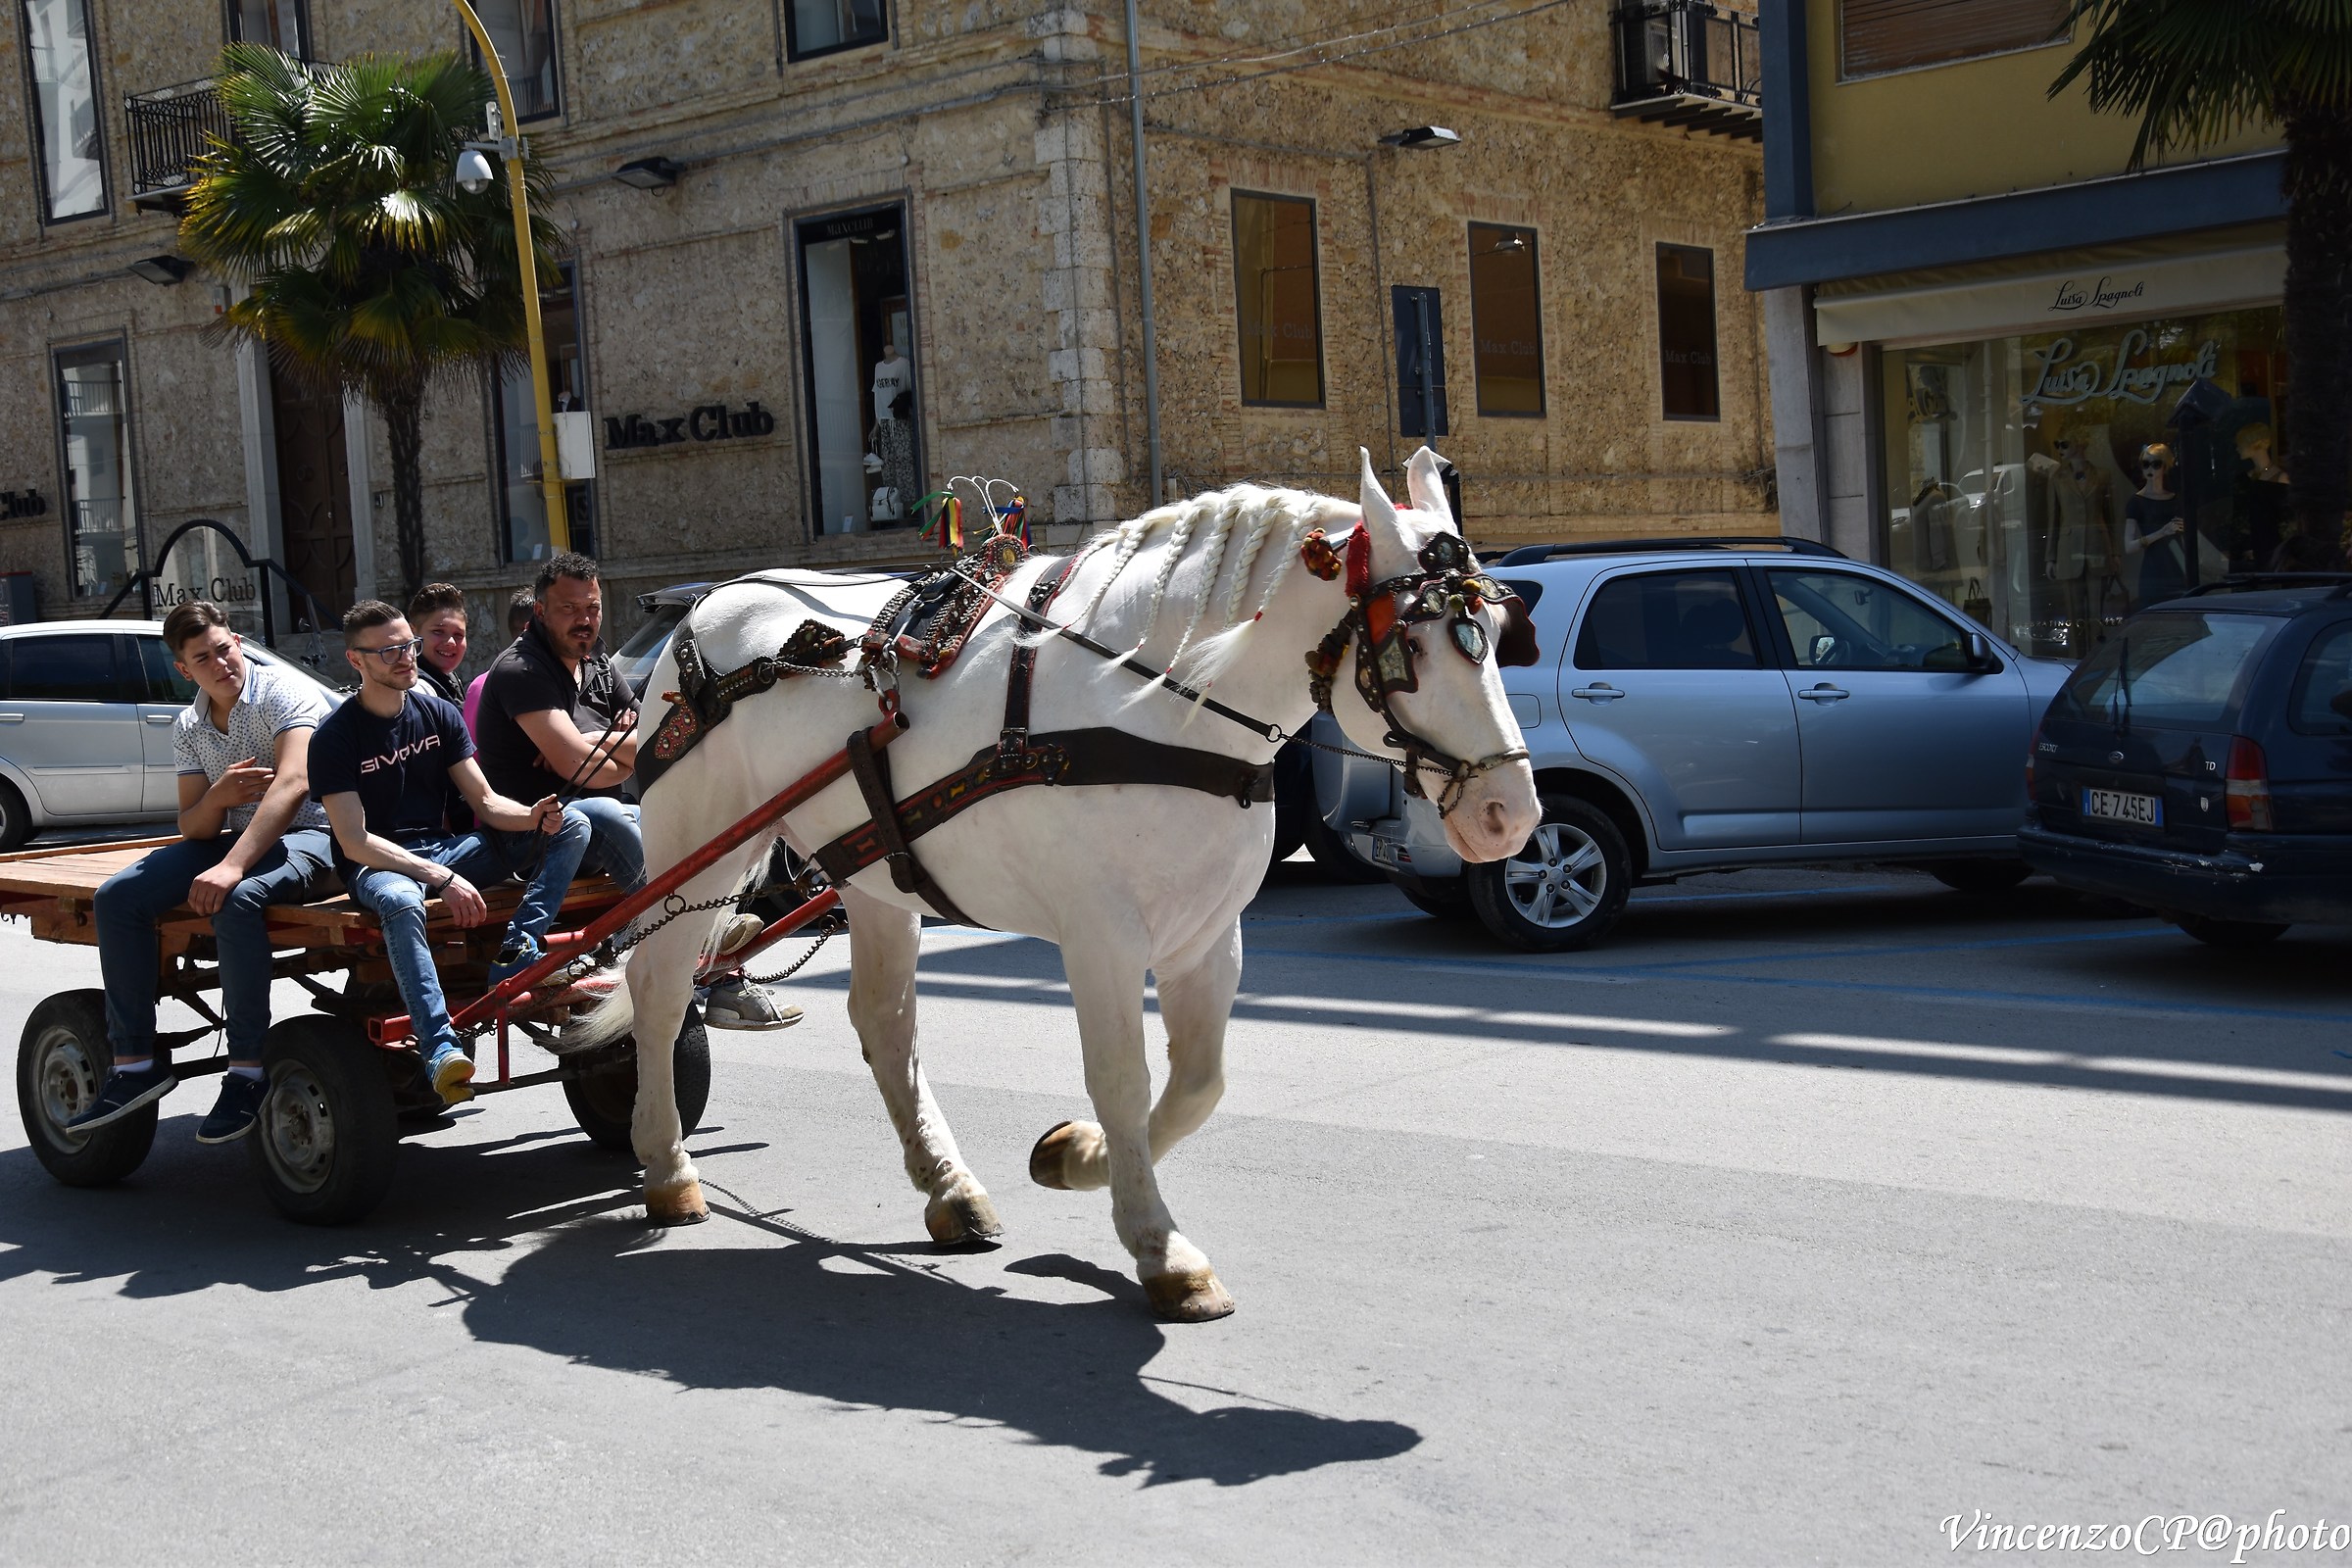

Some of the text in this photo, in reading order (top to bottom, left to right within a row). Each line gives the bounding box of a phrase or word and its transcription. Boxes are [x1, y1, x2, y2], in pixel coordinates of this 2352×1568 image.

[2048, 275, 2144, 312] Luisa Spagnoli
[1283, 321, 1314, 340] Club
[1510, 340, 1537, 356] Club
[2020, 329, 2217, 405] Luisa Spagnoli
[604, 401, 774, 450] Max Club
[153, 576, 256, 608] Max Club
[361, 734, 441, 774] GIVOVA
[2205, 760, 2216, 771] TD
[2091, 791, 2154, 822] CE 745EJ
